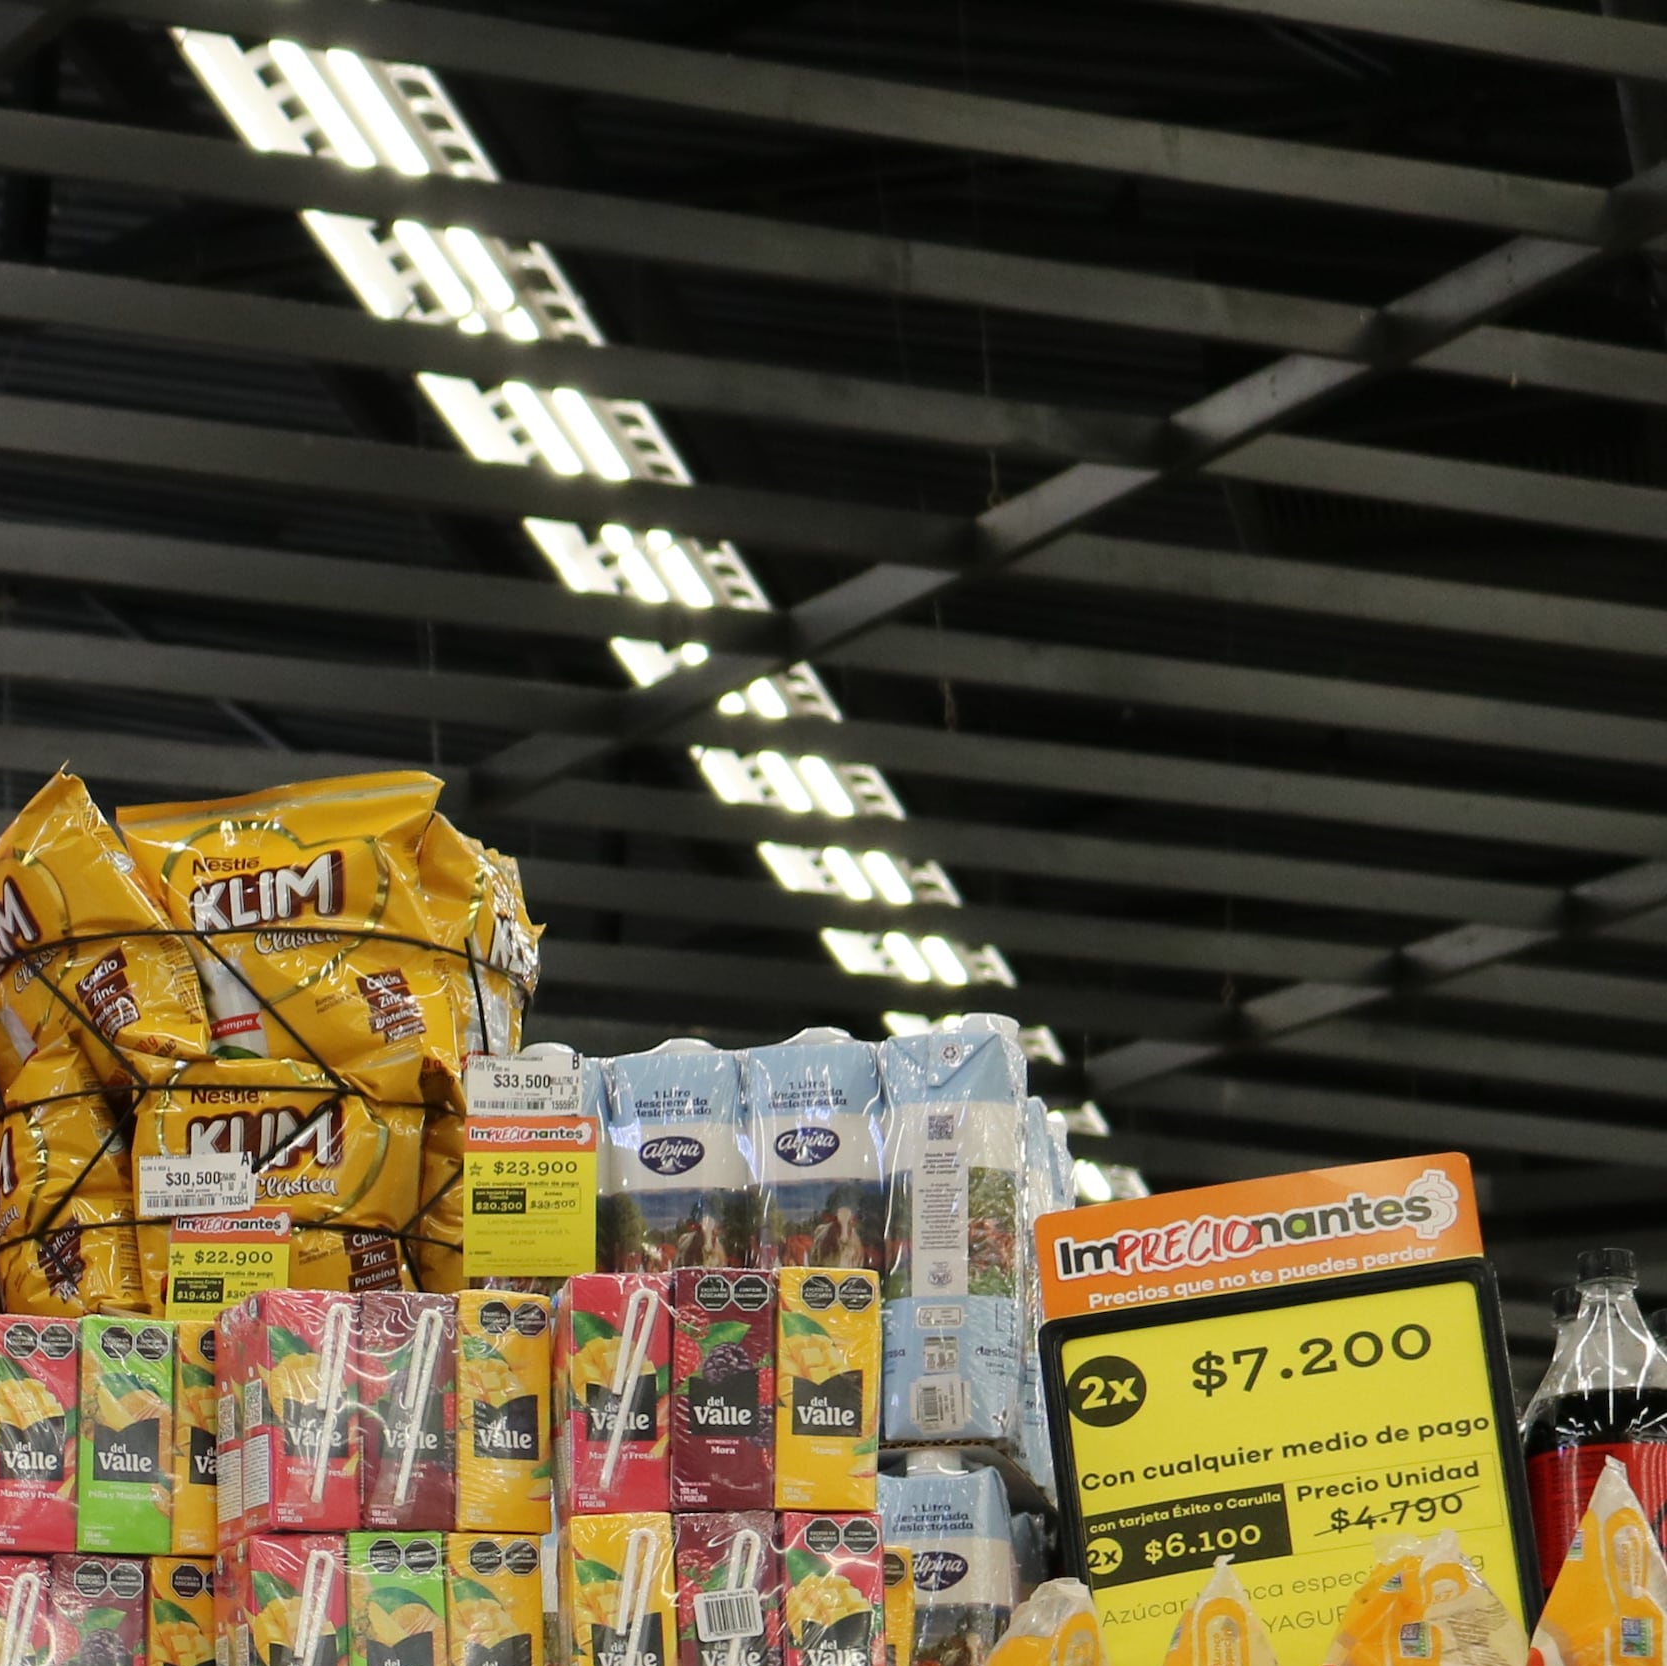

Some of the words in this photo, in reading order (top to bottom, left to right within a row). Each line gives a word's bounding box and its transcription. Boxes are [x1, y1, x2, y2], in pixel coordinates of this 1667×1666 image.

[190, 850, 343, 932] KLIM
[493, 1074, 550, 1090] $33,500
[166, 1171, 220, 1186] $30,500
[494, 1161, 577, 1176] $23.900
[194, 1250, 273, 1265] $22.900
[1089, 1284, 1169, 1309] Precios
[1175, 1279, 1213, 1298] que
[1219, 1273, 1246, 1288] no
[1251, 1269, 1272, 1283] te
[1278, 1258, 1357, 1283] puedes
[1362, 1245, 1436, 1269] perder
[1078, 1376, 1140, 1410] 2x
[1192, 1323, 1431, 1397] $7.200
[707, 1397, 726, 1409] del
[812, 1396, 829, 1408] del
[693, 1407, 751, 1426] Valle
[798, 1406, 855, 1426] Valle
[710, 1444, 736, 1456] Mora
[1081, 1470, 1134, 1491] Con
[1143, 1447, 1273, 1479] cualquier
[1283, 1432, 1367, 1457] medio
[1376, 1425, 1409, 1444] de
[1418, 1416, 1489, 1441] pago
[5, 1450, 57, 1472] Valle
[98, 1450, 152, 1472] Valle
[1297, 1478, 1378, 1502] Precio
[1387, 1461, 1480, 1488] Unidad
[1089, 1521, 1116, 1534] con
[1119, 1509, 1170, 1530] tarjeta
[1172, 1501, 1211, 1520] Éxito
[1214, 1502, 1223, 1511] o
[1227, 1492, 1281, 1509] Carulla
[1145, 1524, 1261, 1564] $6.100
[1330, 1494, 1462, 1533] $4.790
